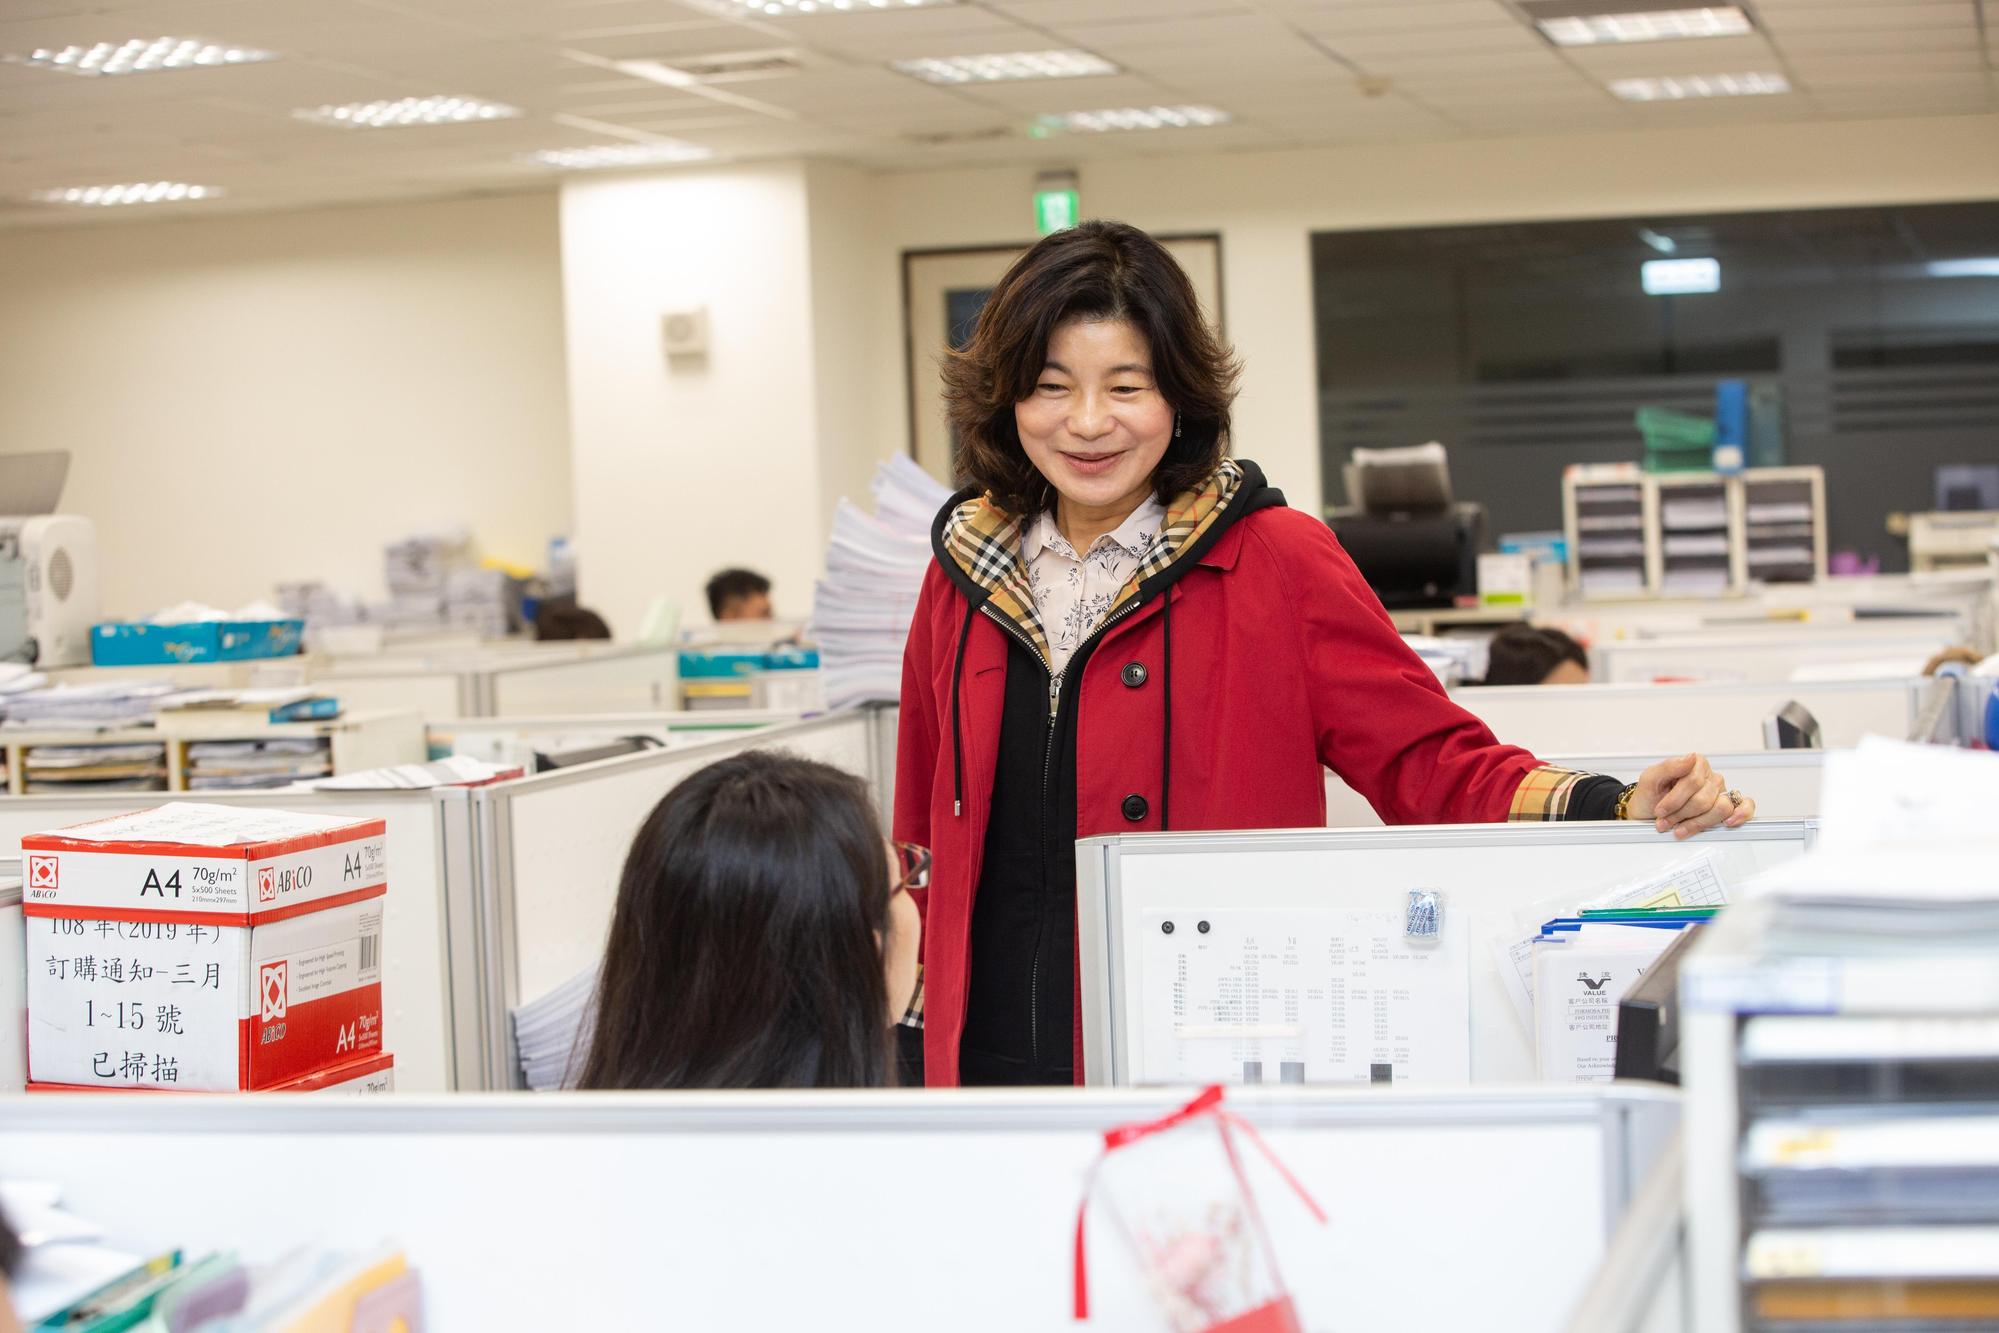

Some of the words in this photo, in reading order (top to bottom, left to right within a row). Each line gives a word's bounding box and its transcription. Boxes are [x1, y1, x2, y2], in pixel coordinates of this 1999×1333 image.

[277, 865, 312, 894] ABiCO
[343, 851, 361, 882] A4
[30, 890, 57, 899] ABiCO
[140, 868, 182, 898] A4
[215, 887, 237, 896] Sheets
[46, 955, 220, 990] 訂購通知-三月
[156, 1004, 184, 1035] 號
[336, 1021, 355, 1054] A4
[93, 1051, 178, 1083] 已掃描
